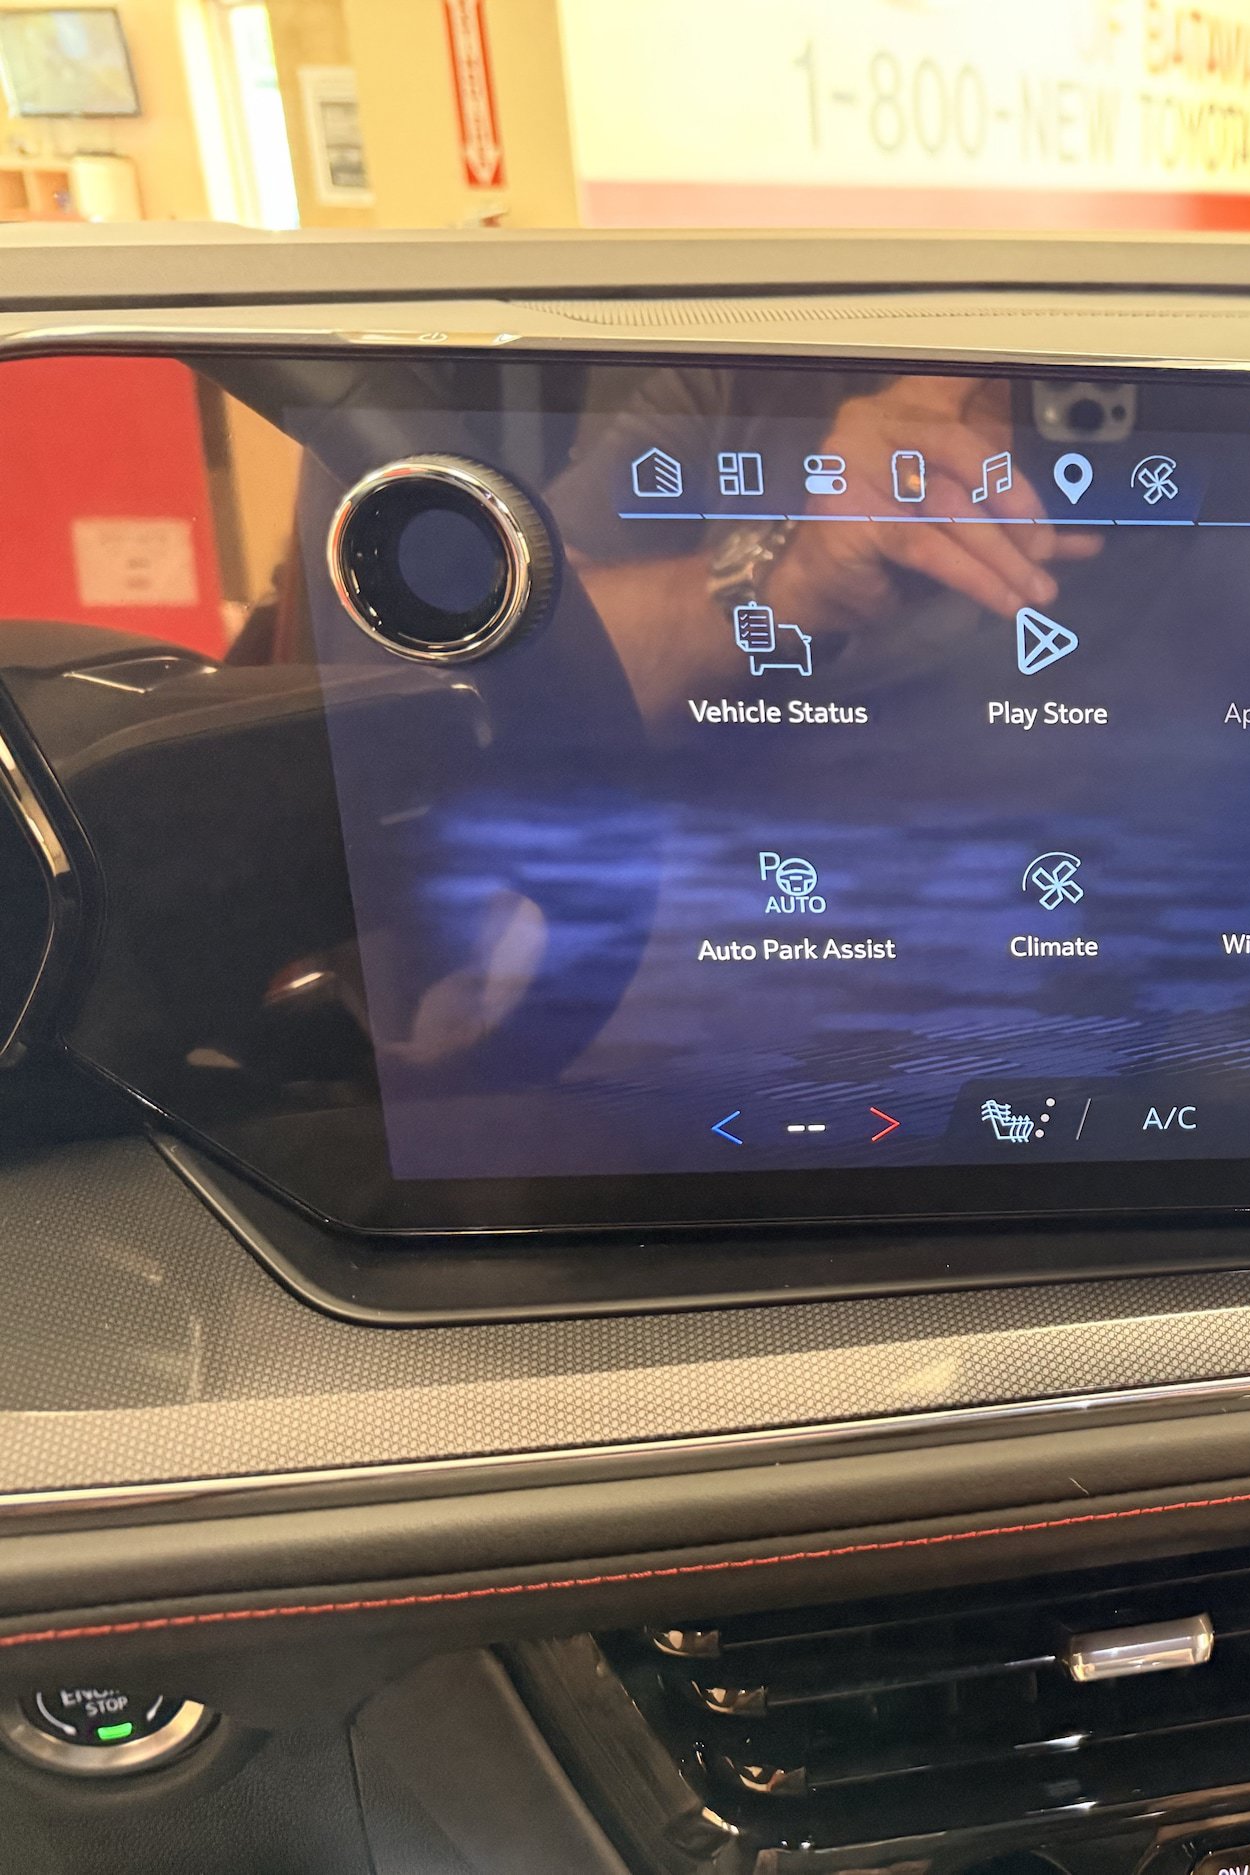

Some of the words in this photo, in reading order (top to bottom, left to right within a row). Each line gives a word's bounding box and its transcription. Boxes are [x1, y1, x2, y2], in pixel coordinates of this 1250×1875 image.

[791, 37, 1121, 162] 1-800-NEW
[688, 698, 782, 724] Vehicle
[787, 700, 868, 724] Status
[987, 700, 1038, 731] Play
[1043, 701, 1108, 725] Store
[764, 894, 827, 914] AUTO
[697, 938, 757, 961] Auto
[763, 937, 818, 960] Park
[822, 937, 897, 960] Assist
[1009, 935, 1099, 957] Climate
[1141, 1106, 1197, 1132] A/C
[84, 1694, 129, 1717] STOP
